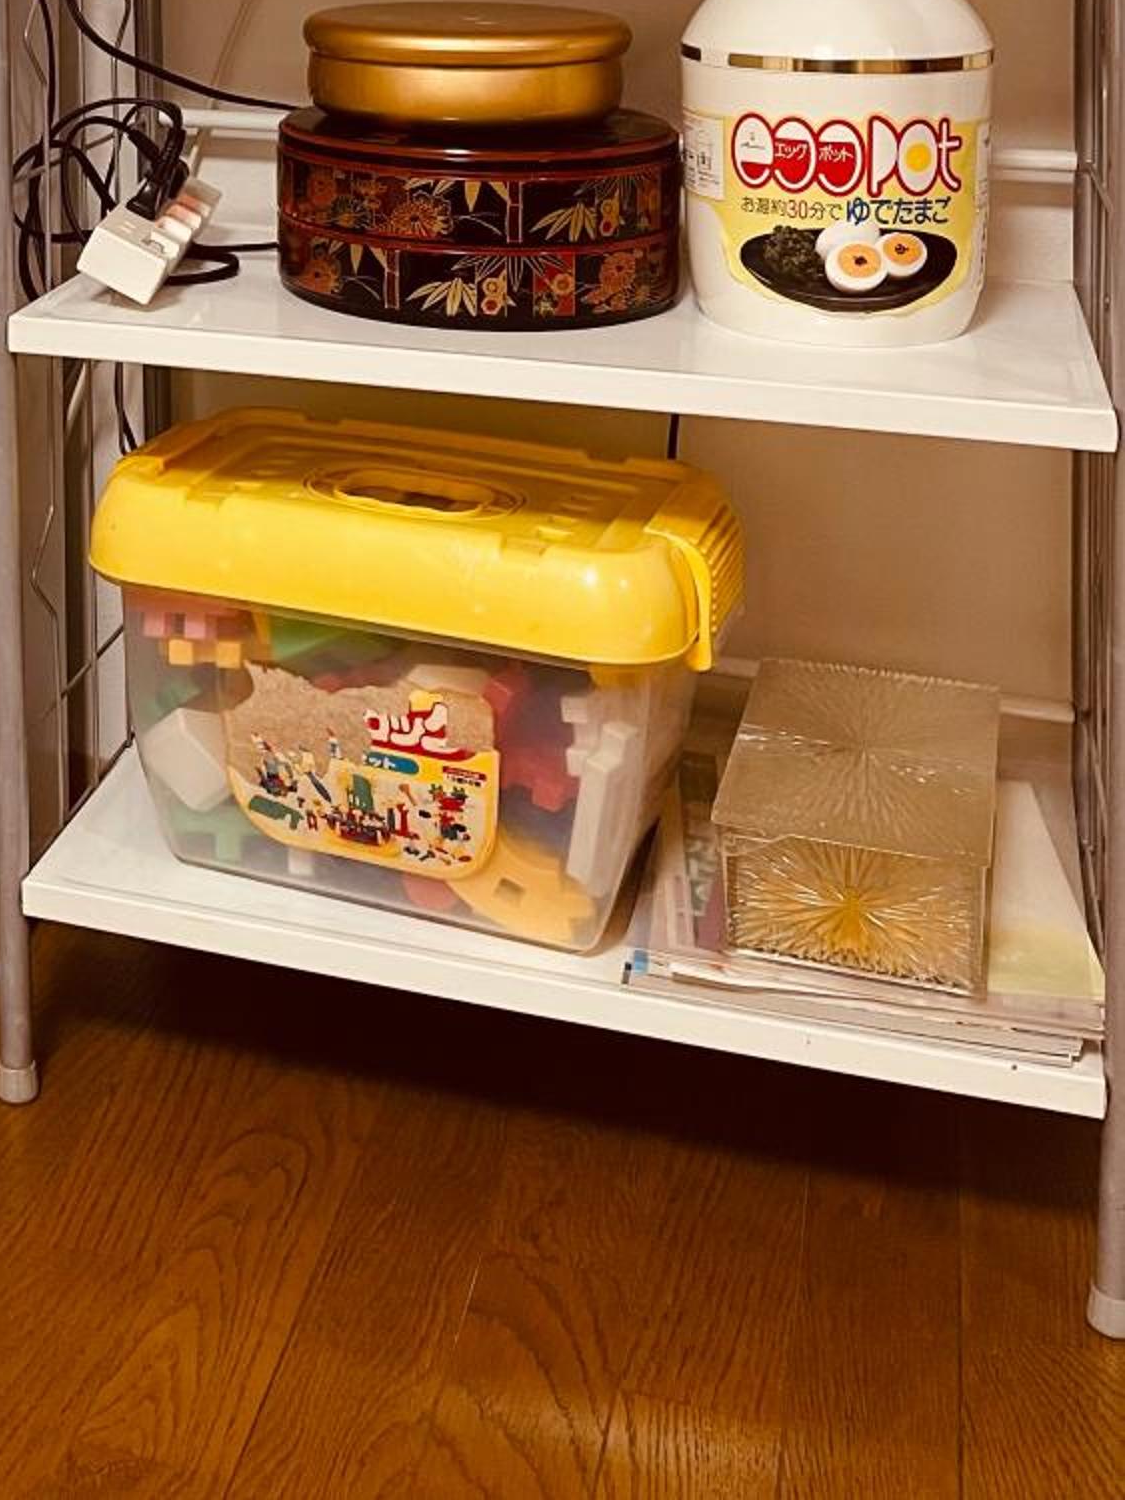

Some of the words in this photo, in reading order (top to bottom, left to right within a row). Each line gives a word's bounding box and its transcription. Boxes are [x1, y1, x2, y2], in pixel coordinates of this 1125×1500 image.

[775, 142, 807, 160] エッグ
[818, 144, 854, 162] ポット
[846, 196, 951, 226] ゆでたまご
